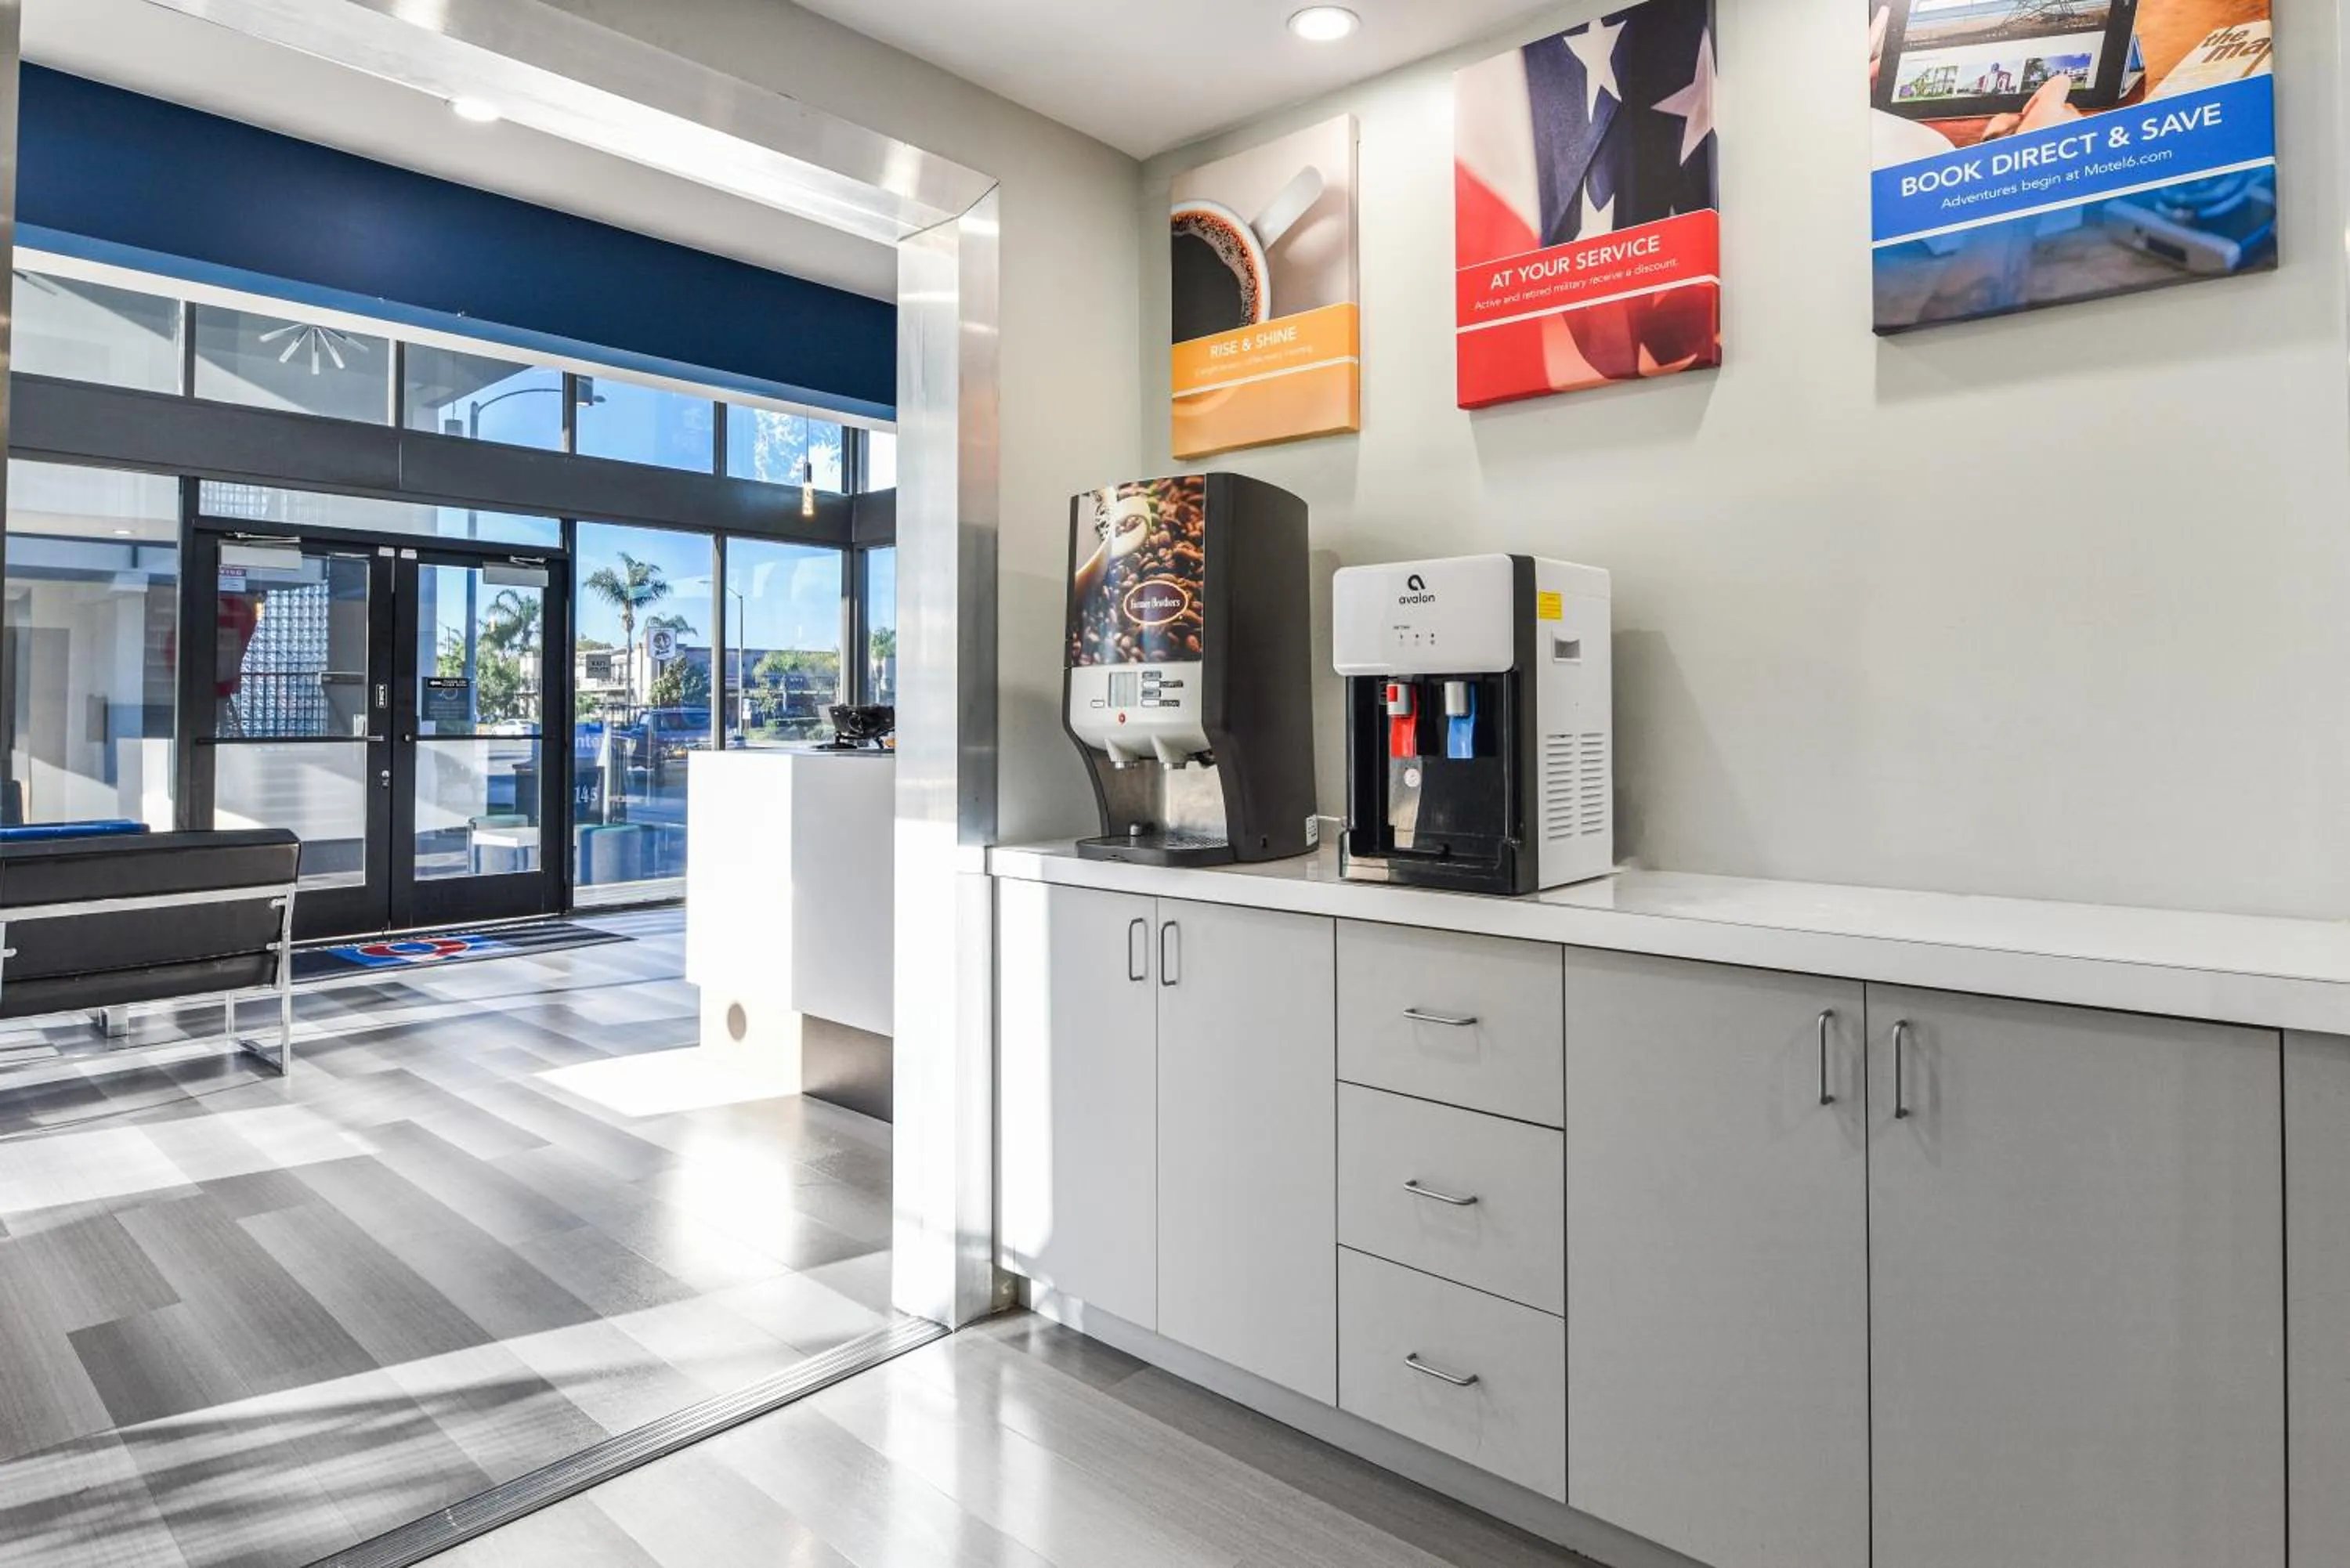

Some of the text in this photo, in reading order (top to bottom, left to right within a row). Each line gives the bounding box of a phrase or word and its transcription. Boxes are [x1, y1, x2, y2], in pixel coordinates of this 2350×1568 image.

[1901, 103, 2222, 197] BOOK DIRECT & SAVE
[1940, 149, 2173, 209] Adventures begin at Motel6.com
[1491, 235, 1660, 290] AT YOUR SERVICE
[1474, 299, 1502, 310] Active
[1504, 292, 1520, 304] and
[1523, 287, 1551, 299] retired
[1554, 280, 1586, 293] military
[1589, 271, 1624, 284] receive
[1209, 325, 1297, 358] RISE & SHINE
[1398, 592, 1435, 605] avalon
